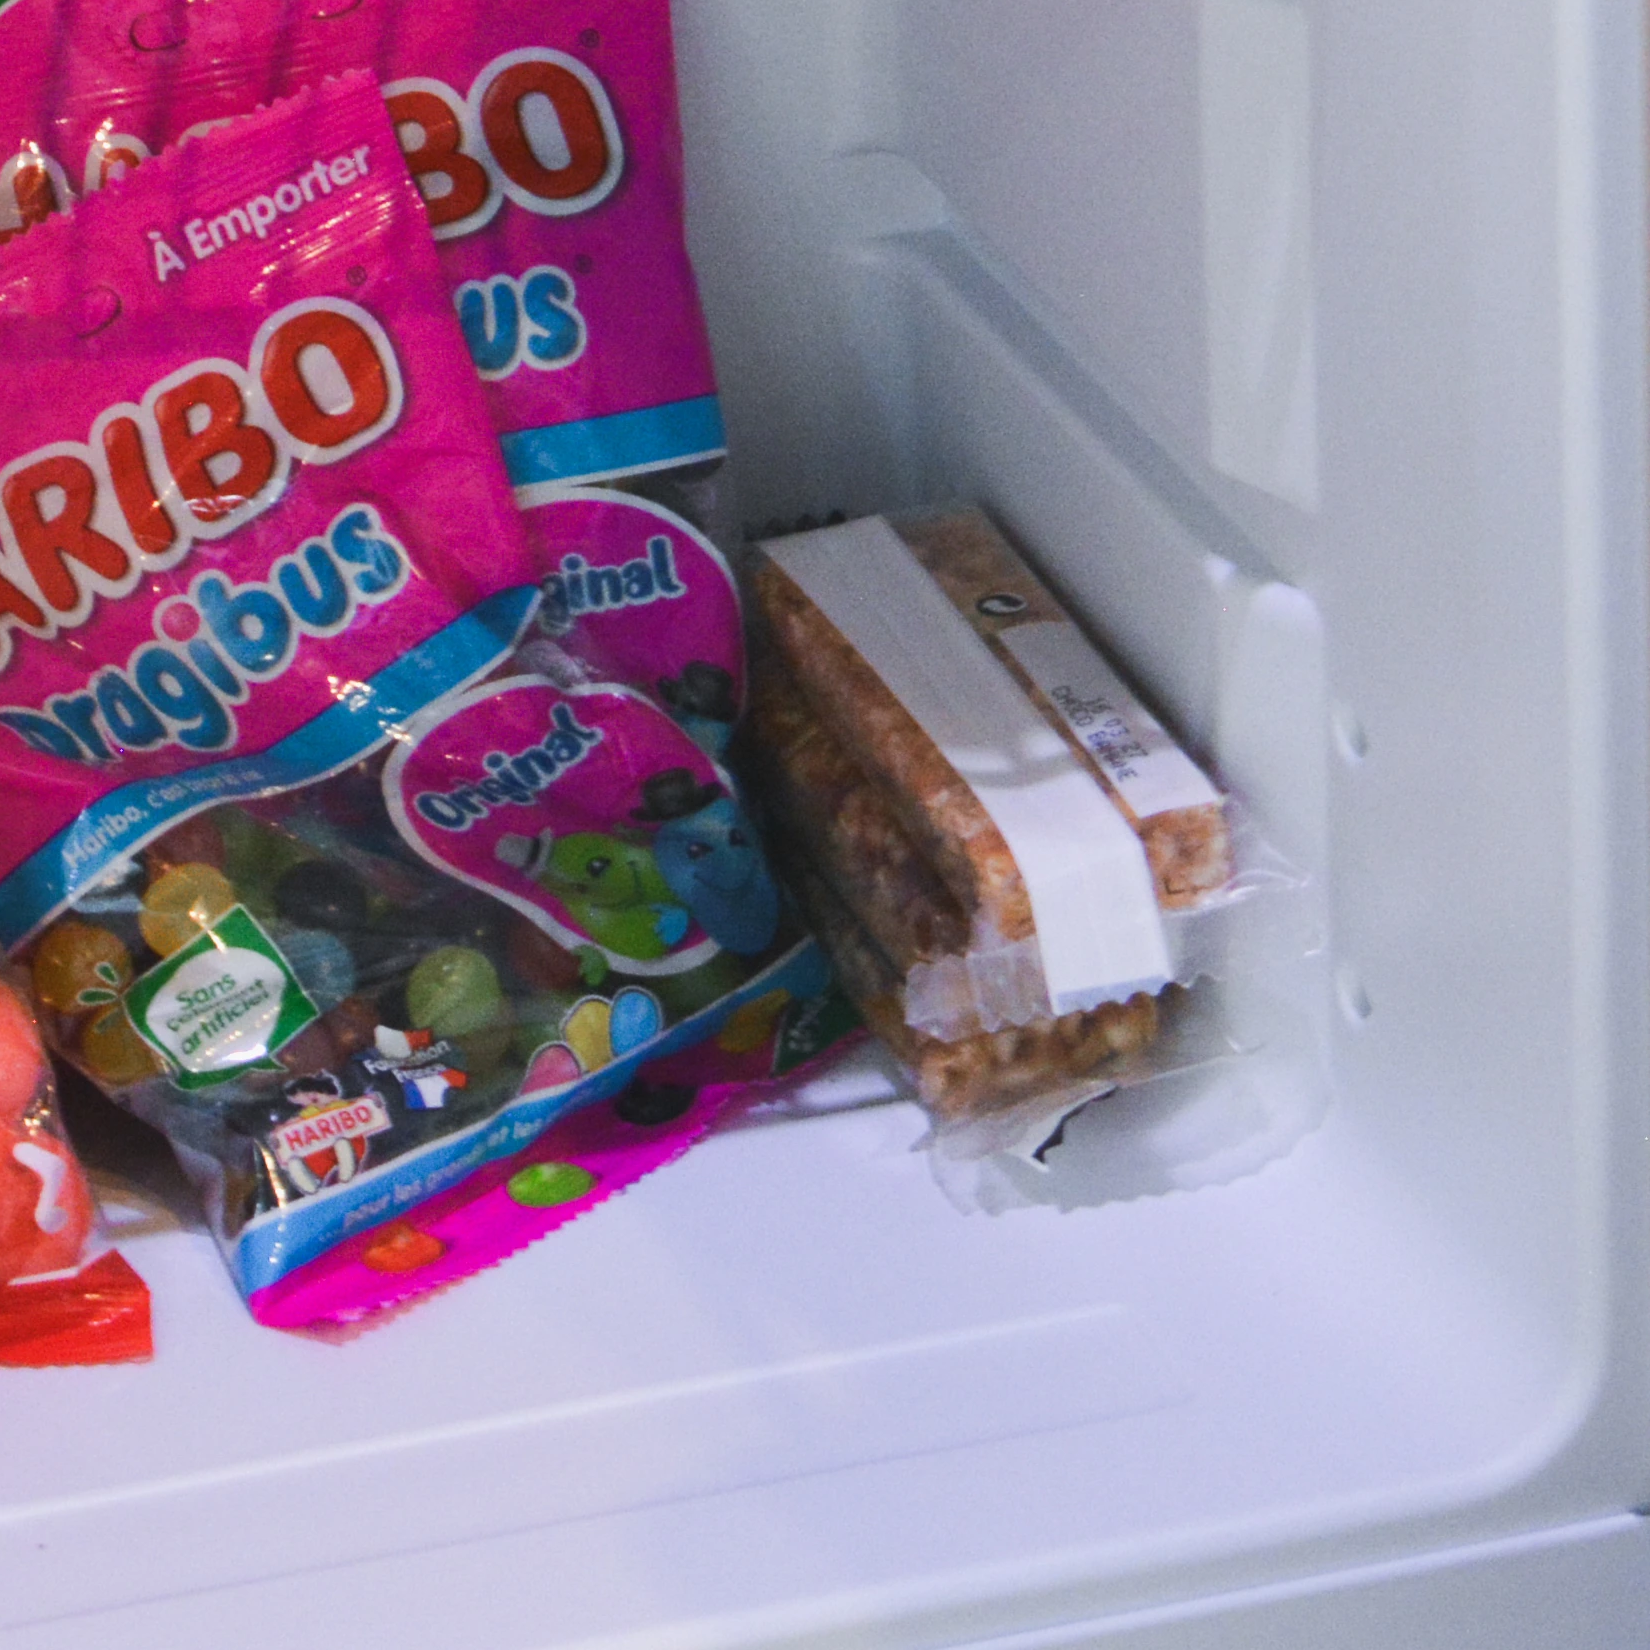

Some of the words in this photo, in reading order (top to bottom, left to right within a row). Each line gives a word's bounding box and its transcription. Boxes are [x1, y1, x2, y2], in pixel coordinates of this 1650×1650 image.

[148, 230, 187, 284] À
[184, 144, 372, 260] Emporter
[418, 703, 606, 833] Original
[175, 972, 238, 1010] Sans
[283, 1103, 373, 1152] HARIBO
